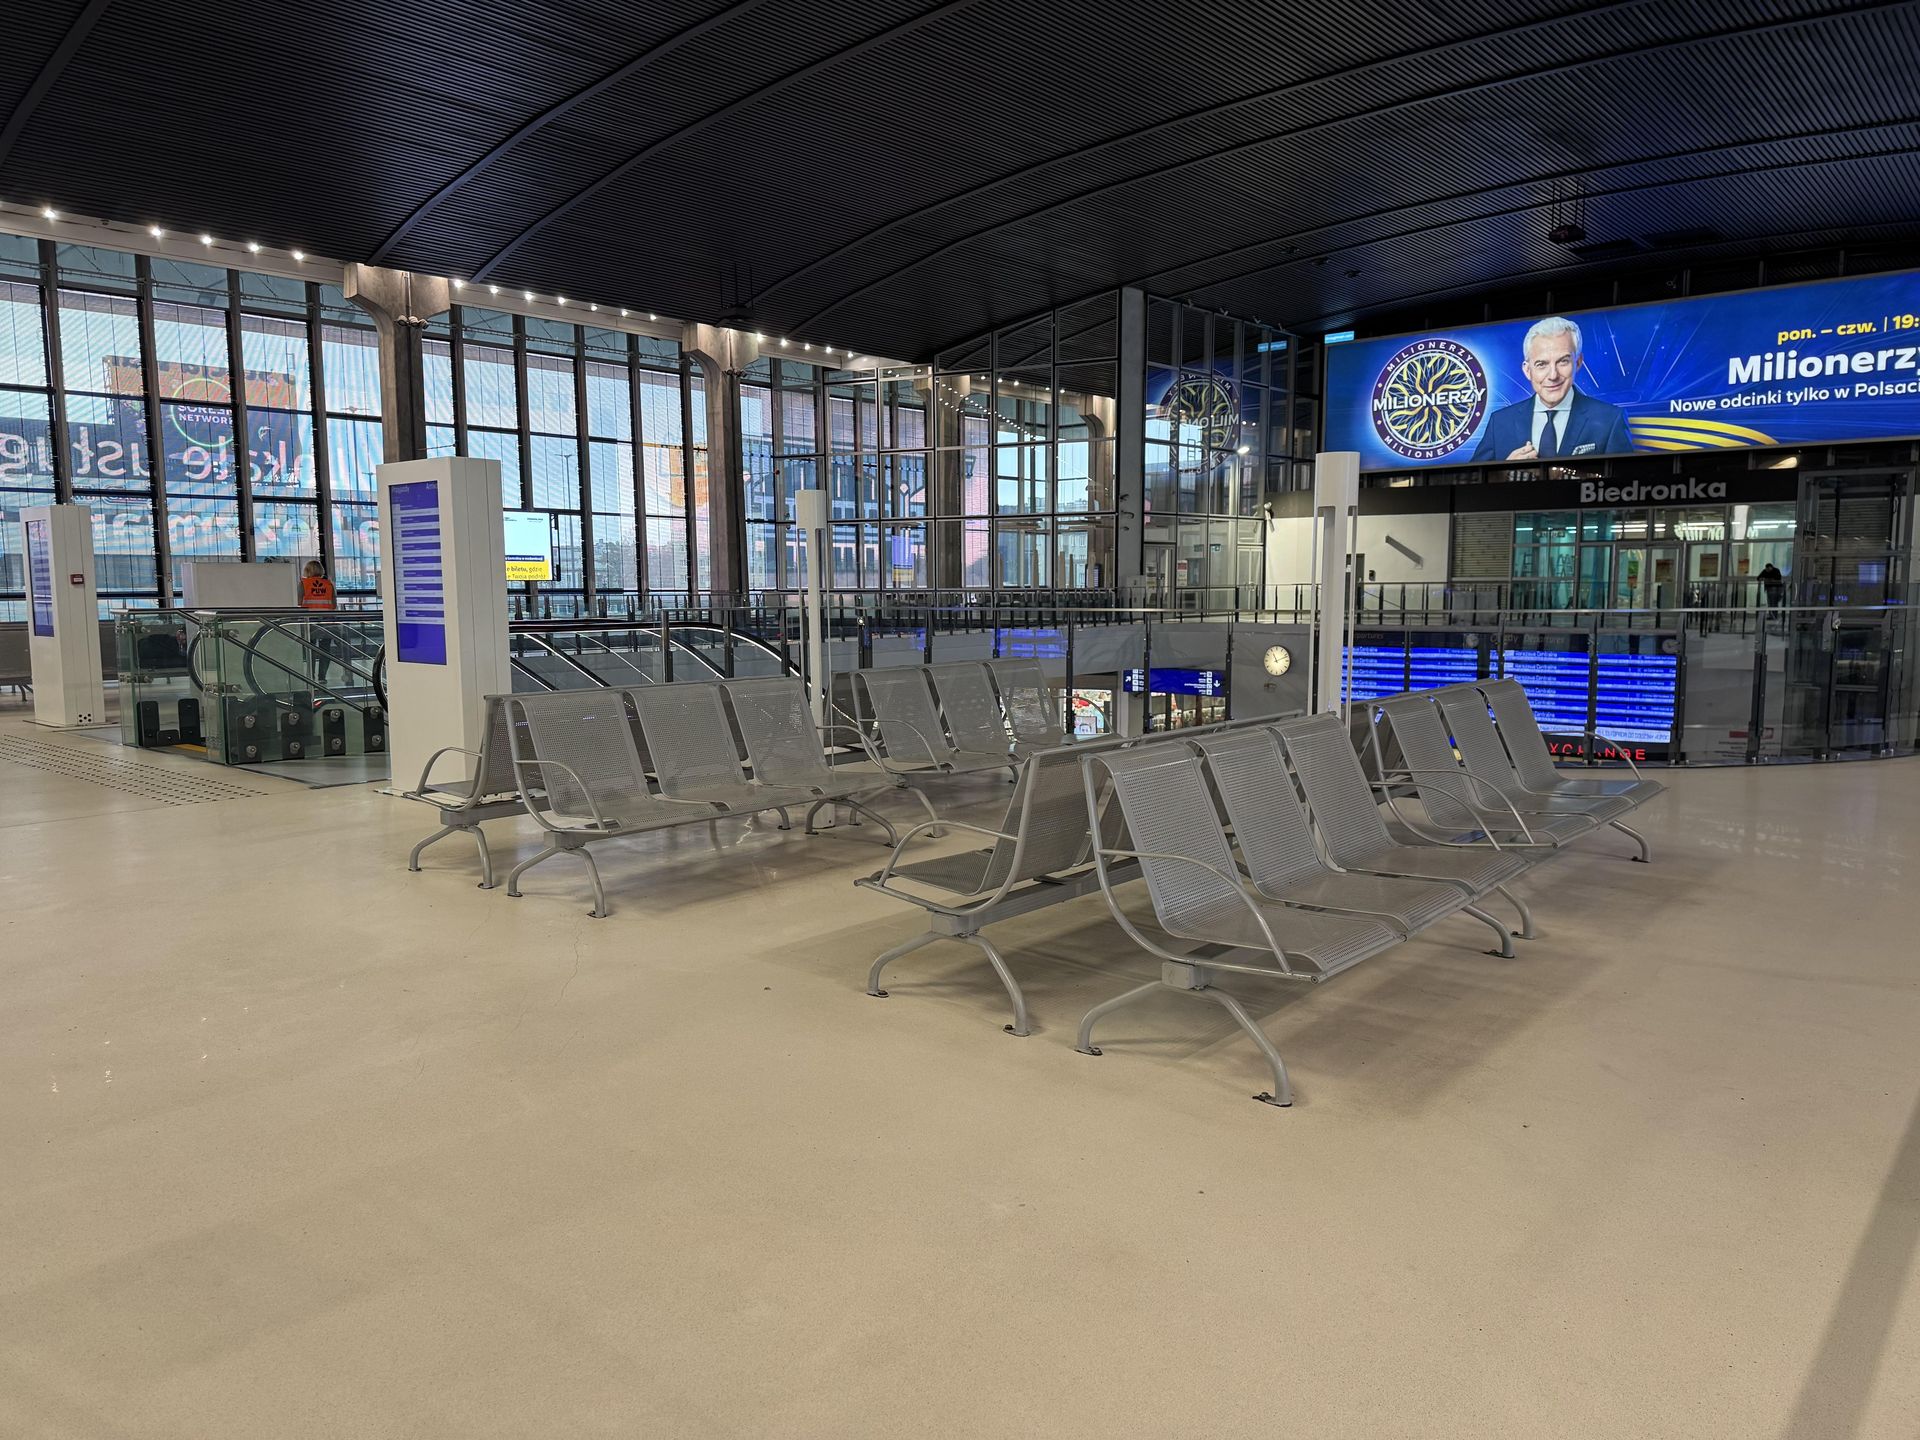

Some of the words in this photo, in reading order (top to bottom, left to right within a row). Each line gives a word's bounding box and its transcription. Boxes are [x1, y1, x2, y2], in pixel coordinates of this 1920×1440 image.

[1777, 327, 1816, 345] pon.
[1836, 321, 1877, 336] czw.
[1892, 313, 1920, 331] 19:
[1386, 341, 1474, 373] MILIONERZY
[1728, 346, 1920, 386] Milionerz
[1373, 388, 1487, 412] MILIONERZY
[1669, 397, 1717, 413] Nowe
[1720, 389, 1782, 409] odcinki
[1785, 386, 1830, 406] tylko
[1833, 387, 1850, 399] w
[1384, 428, 1472, 458] MILIONERZY
[1580, 477, 1727, 503] Biedronka
